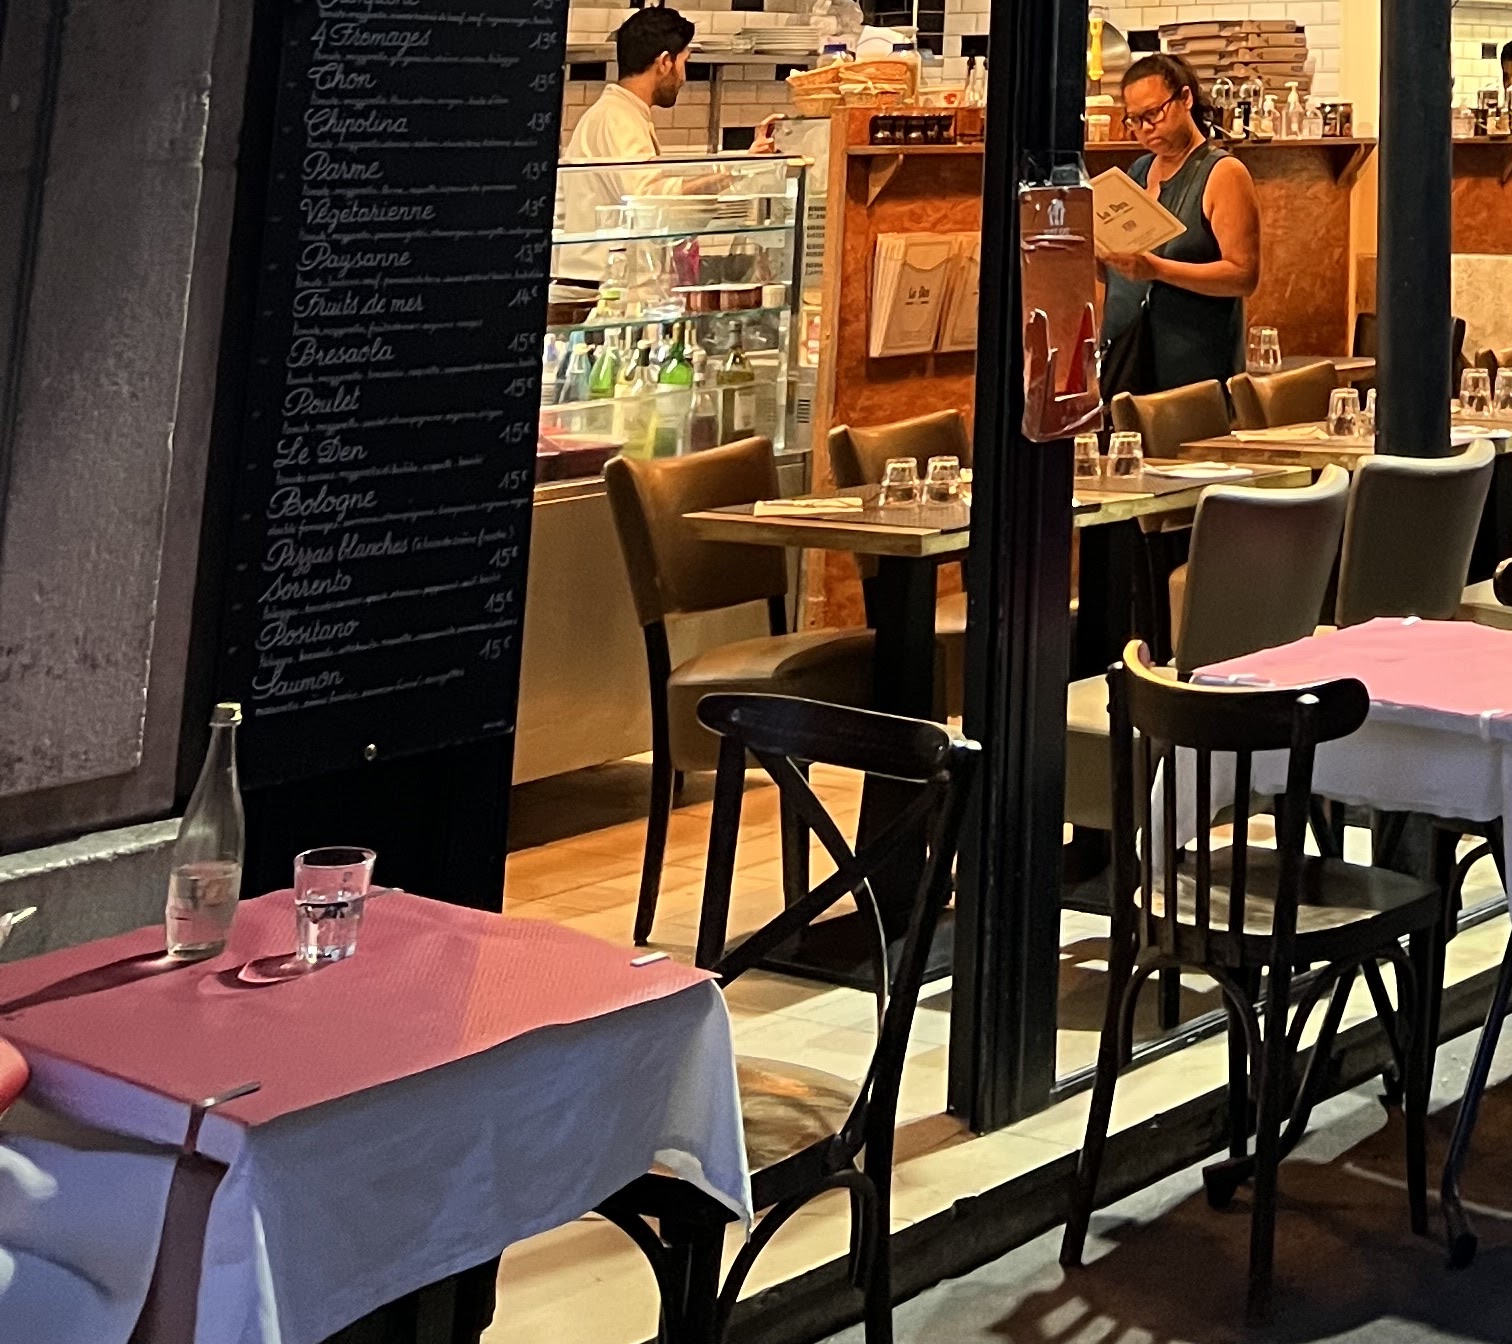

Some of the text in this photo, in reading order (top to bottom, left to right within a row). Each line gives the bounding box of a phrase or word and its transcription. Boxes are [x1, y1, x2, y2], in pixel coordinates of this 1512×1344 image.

[310, 20, 327, 50] 4
[328, 22, 433, 60] Fromages
[528, 31, 558, 50] 13€
[528, 72, 557, 93] 13€
[526, 111, 553, 133] 13€
[302, 150, 550, 182] Parme 13€
[516, 195, 548, 218] 13€
[296, 241, 413, 279] Paysanne
[291, 285, 540, 318] Fruits de mer 14€
[285, 332, 538, 368] Bresaola 15€
[281, 375, 536, 417] Poulet 15€
[272, 423, 532, 470] Le Den 15€
[265, 483, 378, 522] Bologne
[497, 469, 530, 491] 15€
[261, 538, 334, 578] Pizzas
[337, 531, 409, 560] blanches
[488, 545, 520, 567] 15€
[255, 618, 361, 651] Positano
[251, 660, 345, 700] Saumon
[478, 636, 513, 660] 15€
